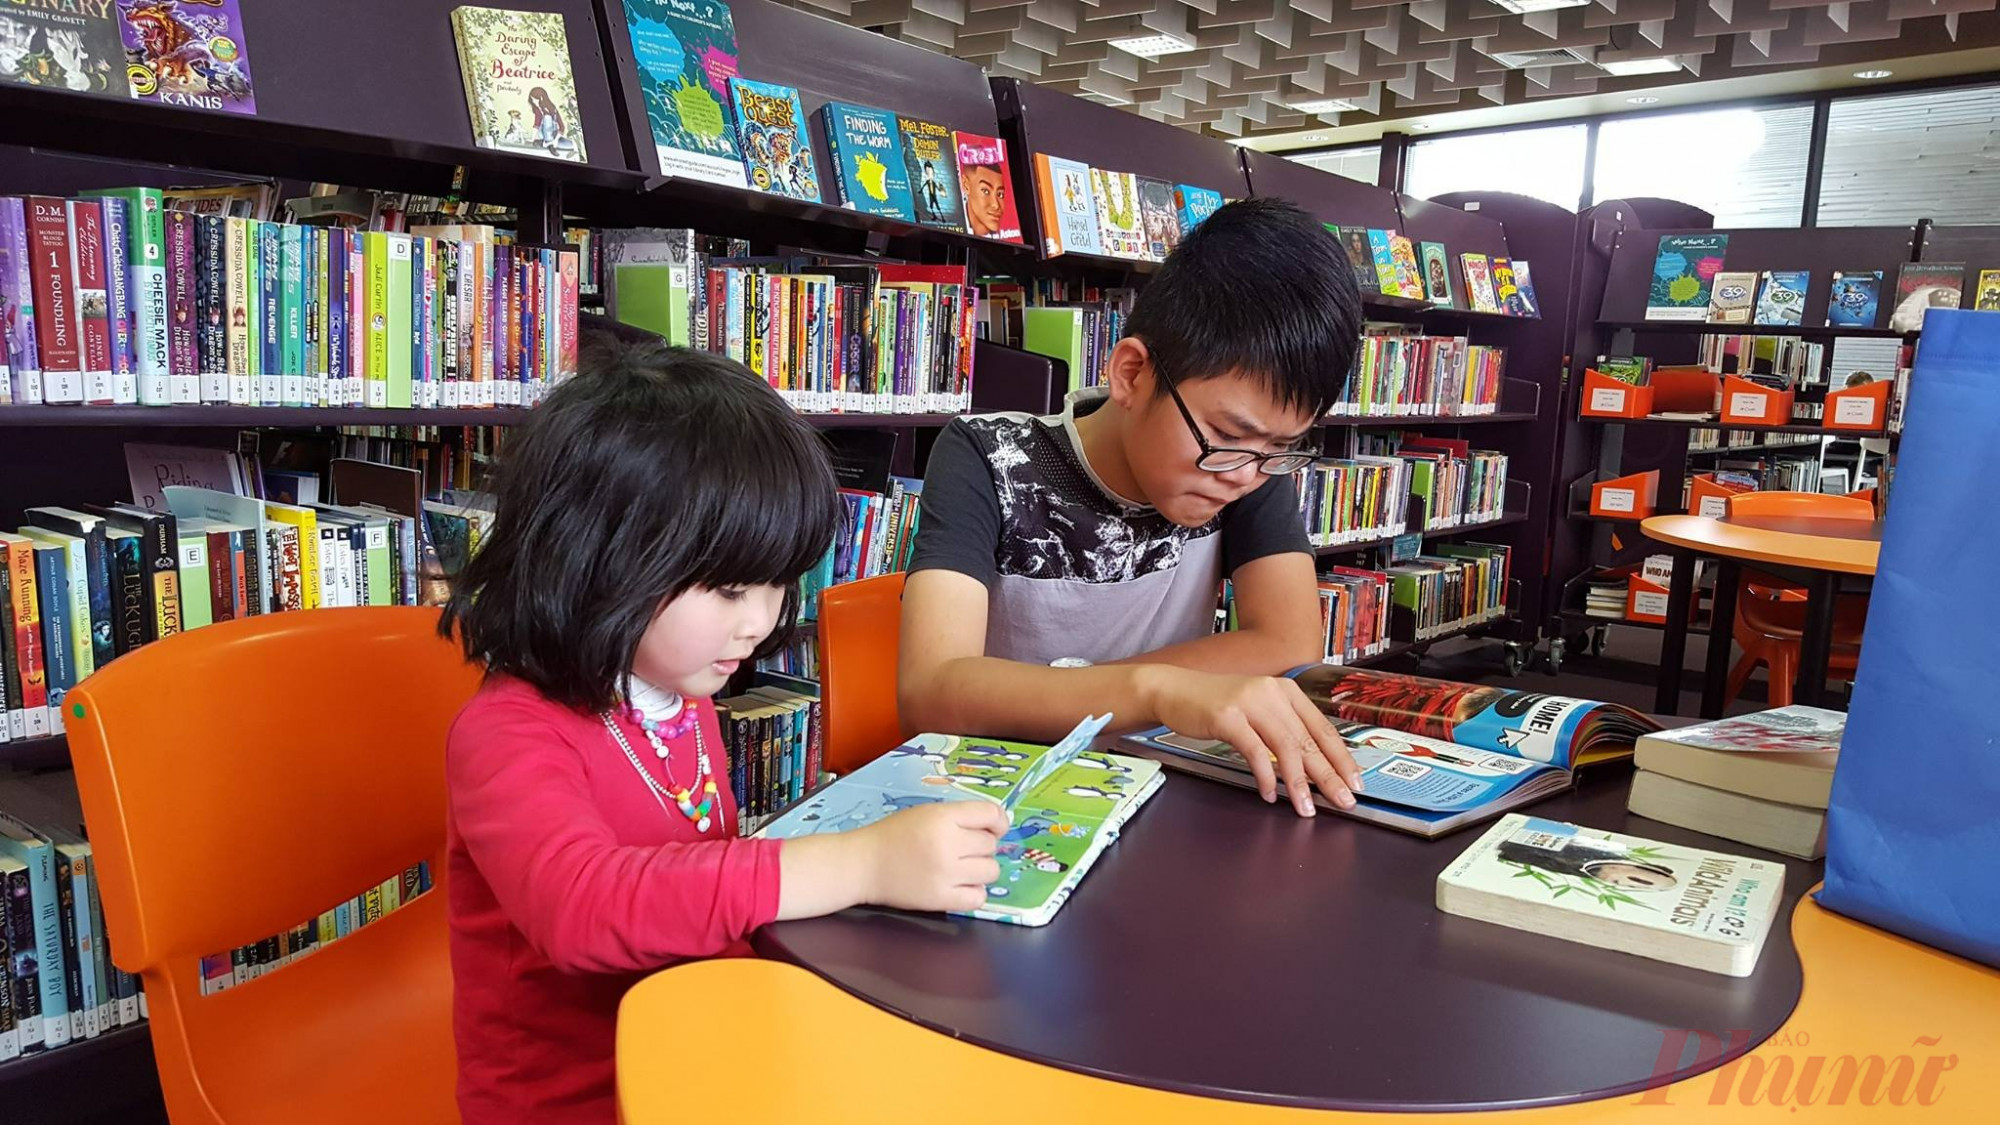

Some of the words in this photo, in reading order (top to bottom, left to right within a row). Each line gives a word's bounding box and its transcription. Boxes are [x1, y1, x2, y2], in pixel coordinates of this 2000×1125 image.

[27, 10, 49, 19] EMILY
[495, 32, 537, 49] Daring
[501, 43, 536, 61] Escape
[491, 58, 556, 79] Beatrice
[160, 92, 223, 109] KANIS
[736, 84, 794, 114] Beast
[744, 106, 796, 131] Quest
[844, 115, 887, 134] FINDING
[846, 132, 866, 145] THE
[867, 134, 892, 149] WORM
[175, 223, 185, 267] CRESSIDA
[210, 228, 218, 271] CRESSIDA
[234, 229, 243, 272] CRESSIDA
[397, 243, 405, 254] D
[50, 251, 59, 268] 1
[175, 268, 186, 301] COWELL
[375, 264, 383, 282] Judi
[676, 274, 682, 282] G
[144, 289, 153, 303] NOT
[152, 273, 163, 326] CHEESIE
[210, 272, 219, 305] COWELL
[235, 273, 244, 306] COWELL
[375, 283, 383, 309] Curtin
[463, 273, 473, 302] CAESAR
[698, 278, 706, 303] GRACE
[1724, 286, 1744, 297] 39
[1775, 290, 1792, 300] 39
[1846, 293, 1865, 302] 39
[50, 274, 67, 346] FOUNDLING
[145, 305, 155, 333] EXACTLY
[268, 298, 276, 344] REVENGE
[773, 292, 781, 334] KENSINGTON
[290, 307, 298, 339] KILLER
[95, 334, 103, 362] DINEY
[147, 335, 156, 361] FAMOUS
[154, 328, 166, 368] MACK
[173, 326, 183, 361] Dragon's
[182, 330, 190, 347] How
[207, 326, 217, 362] Dragon's
[215, 331, 224, 347] How
[238, 334, 246, 349] How
[158, 524, 167, 554] DURHAM
[247, 533, 256, 549] THE
[282, 534, 297, 543] THE
[373, 532, 382, 544] F
[17, 549, 30, 574] Maze
[189, 550, 199, 562] E
[247, 555, 258, 590] JAGUAR
[1646, 567, 1661, 576] WHO
[76, 579, 87, 606] Cupid
[124, 573, 141, 617] LUCK
[164, 577, 172, 595] THE
[19, 579, 32, 622] Running
[78, 607, 89, 633] Cakes
[162, 595, 178, 636] LUCK
[1528, 701, 1570, 735] HOME!
[41, 855, 49, 882] FLEMING
[1695, 858, 1737, 882] Wild
[1735, 879, 1760, 893] Who
[42, 903, 55, 920] THE
[1670, 877, 1725, 927] Animals
[1728, 894, 1748, 907] am
[45, 924, 59, 973] SATURDAY
[49, 977, 62, 996] BOY
